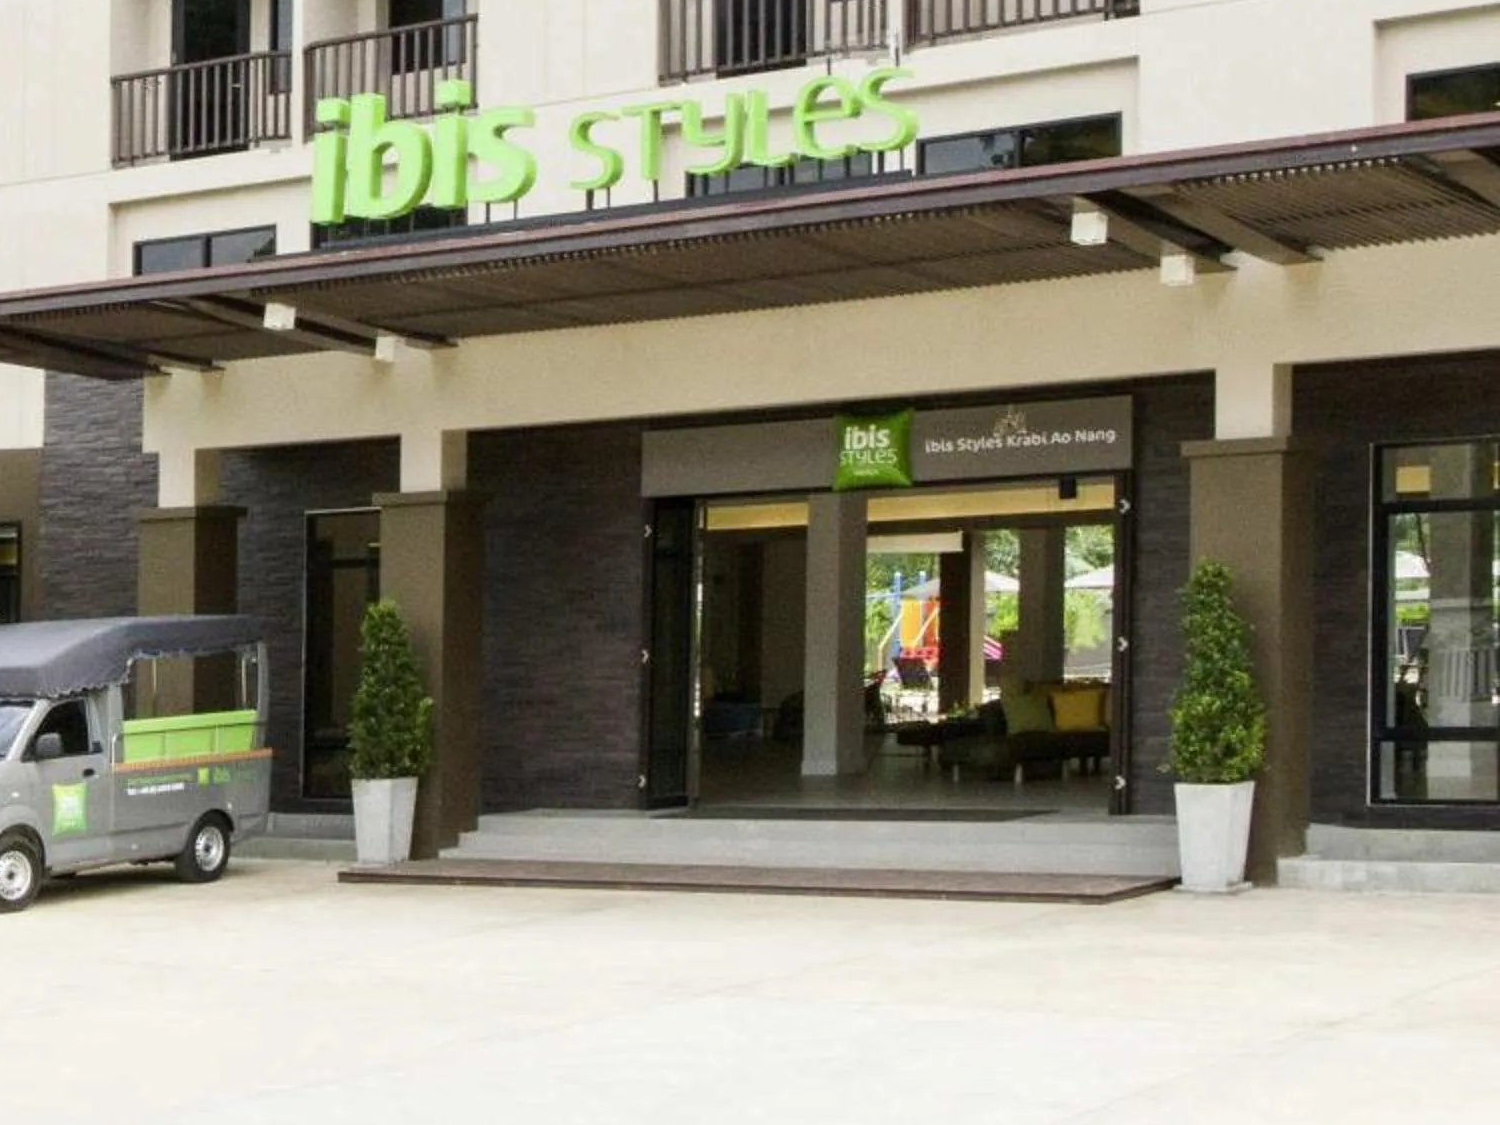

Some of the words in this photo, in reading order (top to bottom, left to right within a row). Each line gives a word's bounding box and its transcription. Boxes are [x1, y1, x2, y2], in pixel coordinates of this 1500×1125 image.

[309, 78, 538, 226] ibis
[844, 423, 891, 450] ibis
[956, 435, 1003, 453] Styles
[1007, 432, 1047, 448] Krabi
[1050, 431, 1071, 444] Ao
[1075, 428, 1117, 444] Nang
